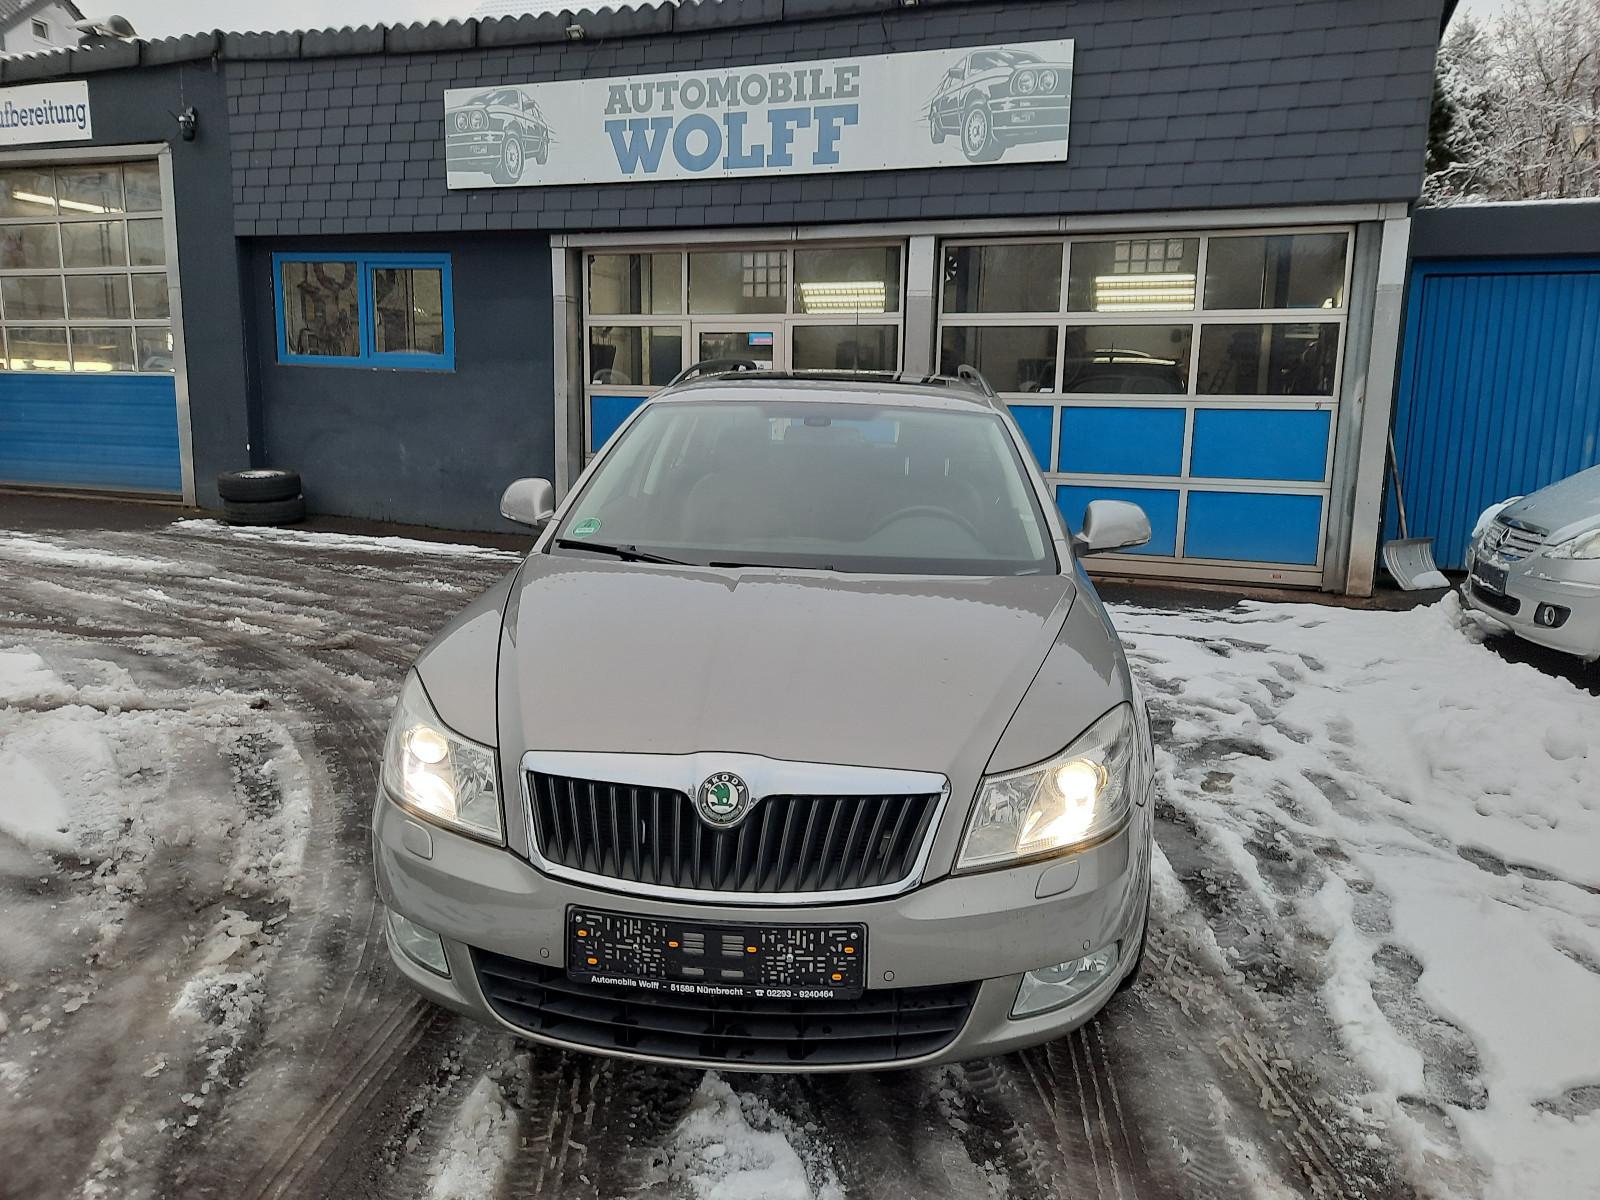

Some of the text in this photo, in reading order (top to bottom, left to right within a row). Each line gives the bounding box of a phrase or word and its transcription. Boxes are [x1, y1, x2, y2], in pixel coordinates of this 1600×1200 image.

[604, 65, 860, 115] AUTOMOBILE
[604, 104, 859, 174] WOLFF
[591, 975, 637, 988] Automobile
[638, 980, 660, 990] Wolff
[696, 985, 744, 997] Nümbrecht
[766, 989, 792, 998] 02293
